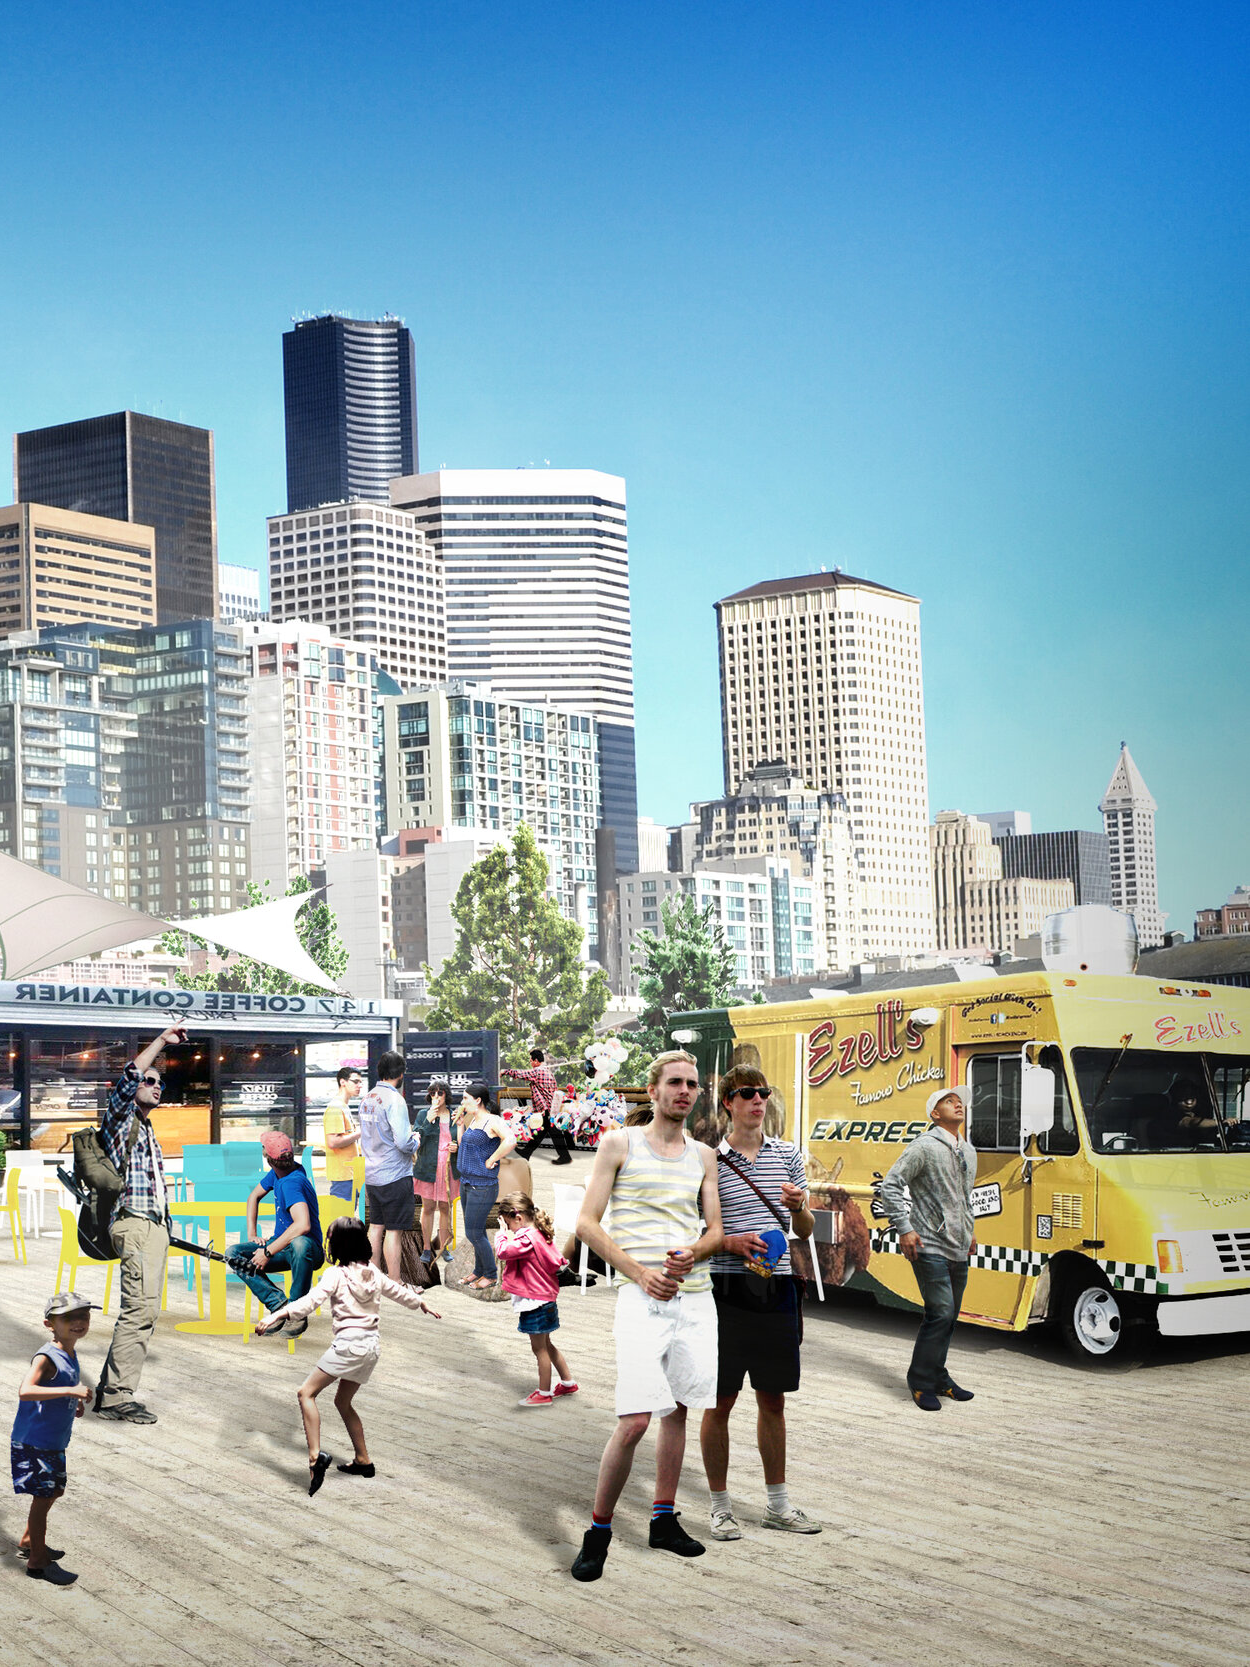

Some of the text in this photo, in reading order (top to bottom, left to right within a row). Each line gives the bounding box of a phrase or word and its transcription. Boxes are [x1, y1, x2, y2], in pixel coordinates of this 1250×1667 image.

[806, 999, 924, 1085] Ezell's
[1154, 1011, 1242, 1046] Ezell's
[810, 1120, 935, 1143] EXPRES
